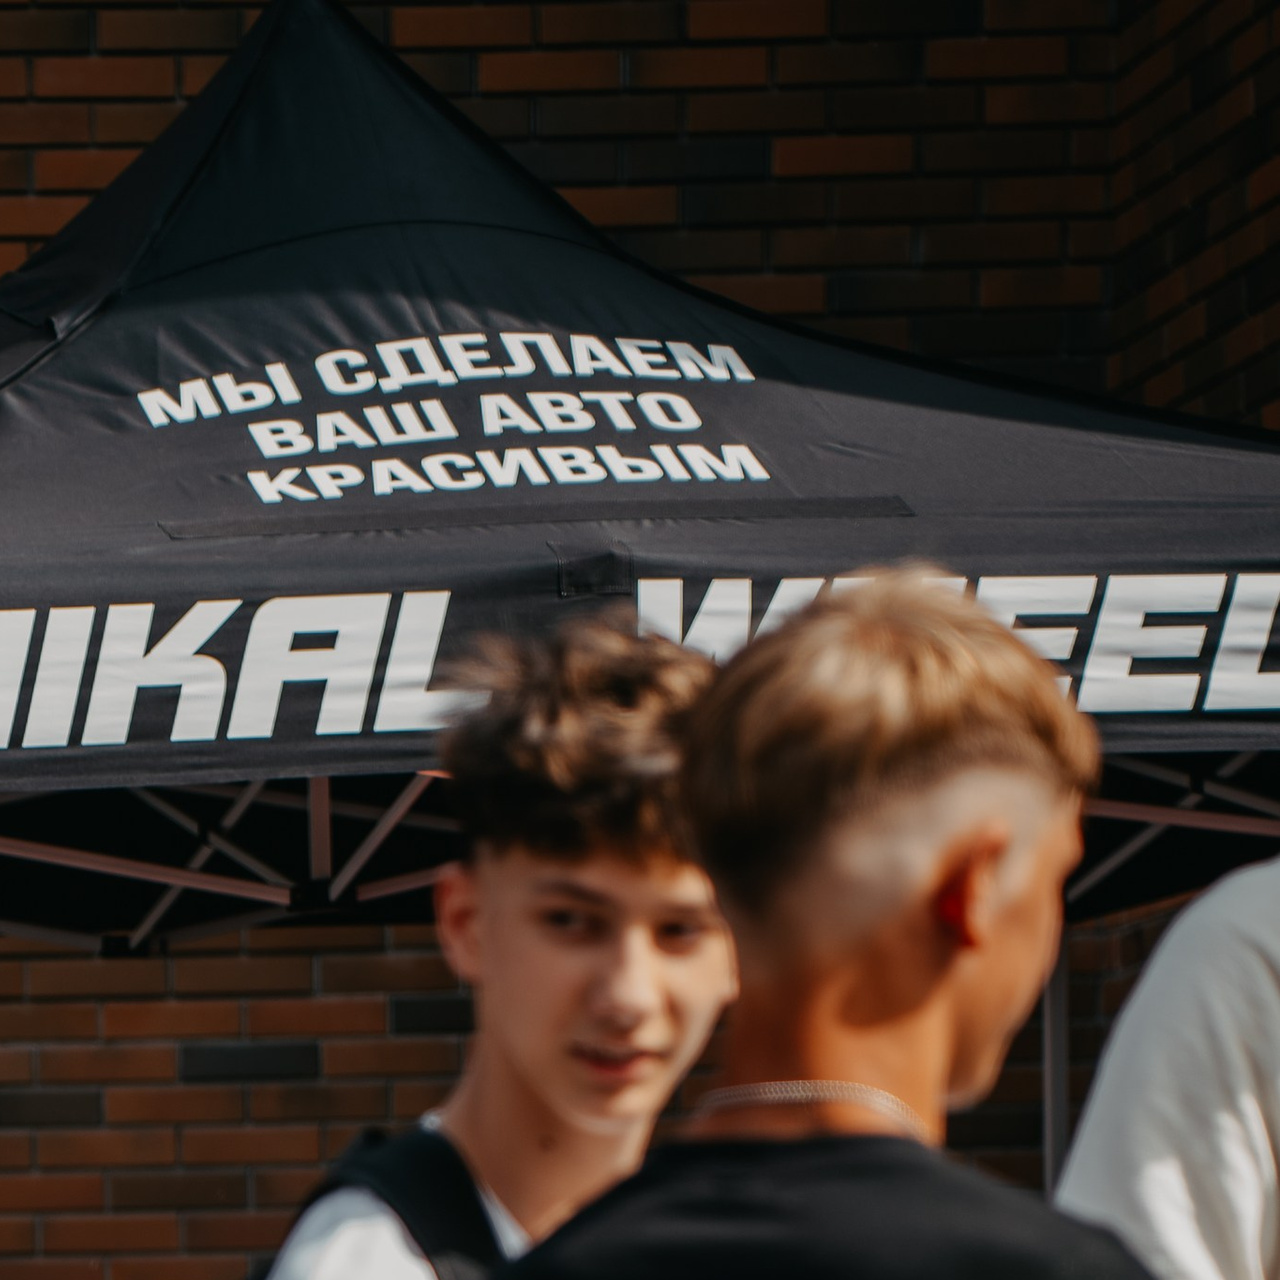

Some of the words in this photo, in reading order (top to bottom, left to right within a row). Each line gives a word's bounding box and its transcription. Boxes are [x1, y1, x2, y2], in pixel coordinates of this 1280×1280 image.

[136, 361, 303, 428] МЫ
[314, 332, 757, 394] СДЕЛАЕМ
[247, 398, 460, 459] ВАШ
[479, 391, 704, 437] АВТО
[246, 444, 772, 503] КРАСИВЫМ
